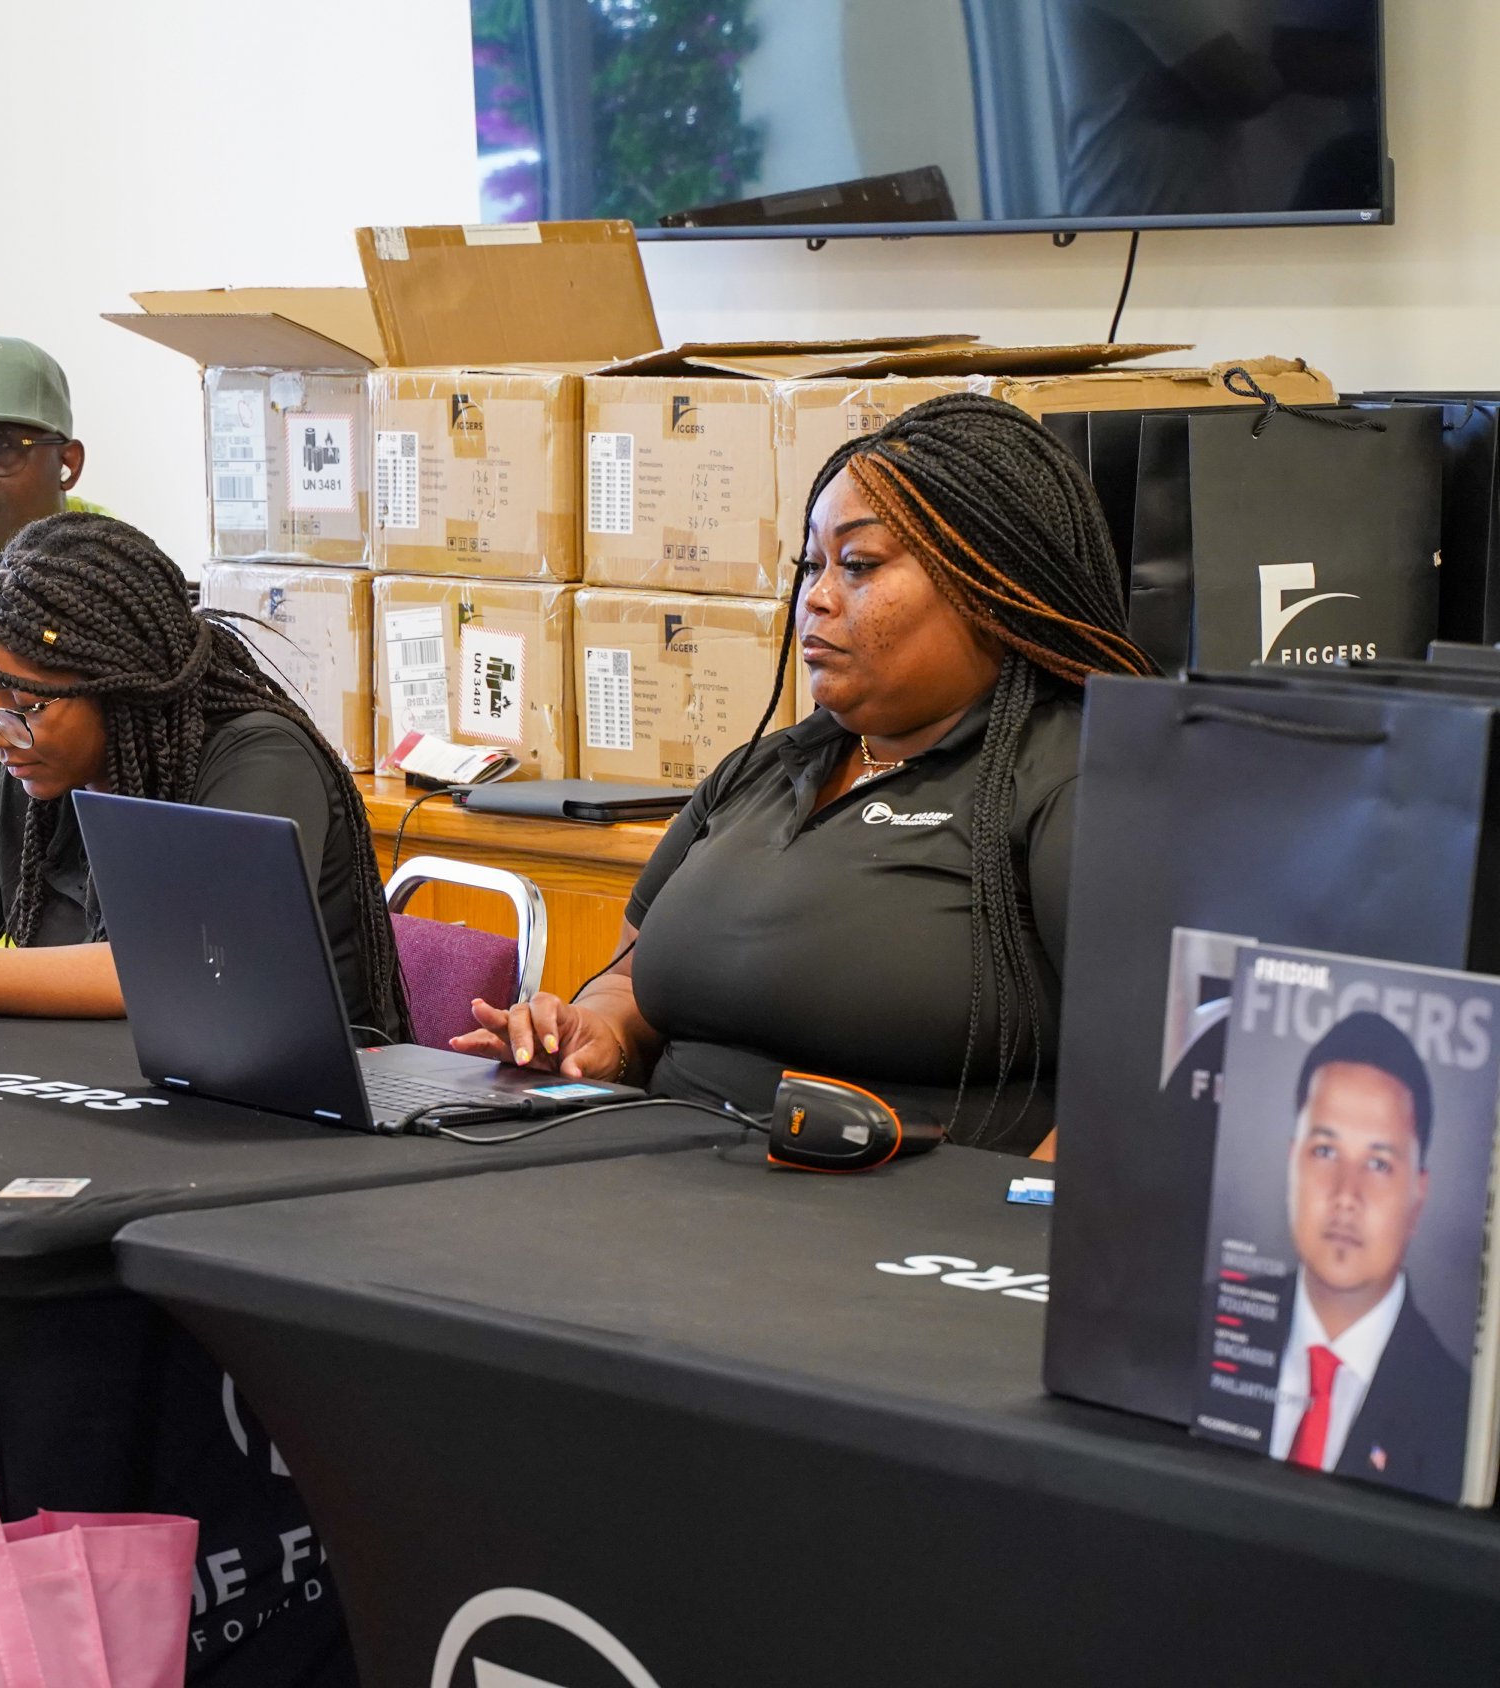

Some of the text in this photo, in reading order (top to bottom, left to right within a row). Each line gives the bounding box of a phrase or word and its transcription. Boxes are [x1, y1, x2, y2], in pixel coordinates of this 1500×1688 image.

[303, 480, 342, 490] UN 3481
[1281, 643, 1376, 665] FIGGERS
[473, 653, 482, 715] UN 3481
[1254, 957, 1331, 990] FREDDIE
